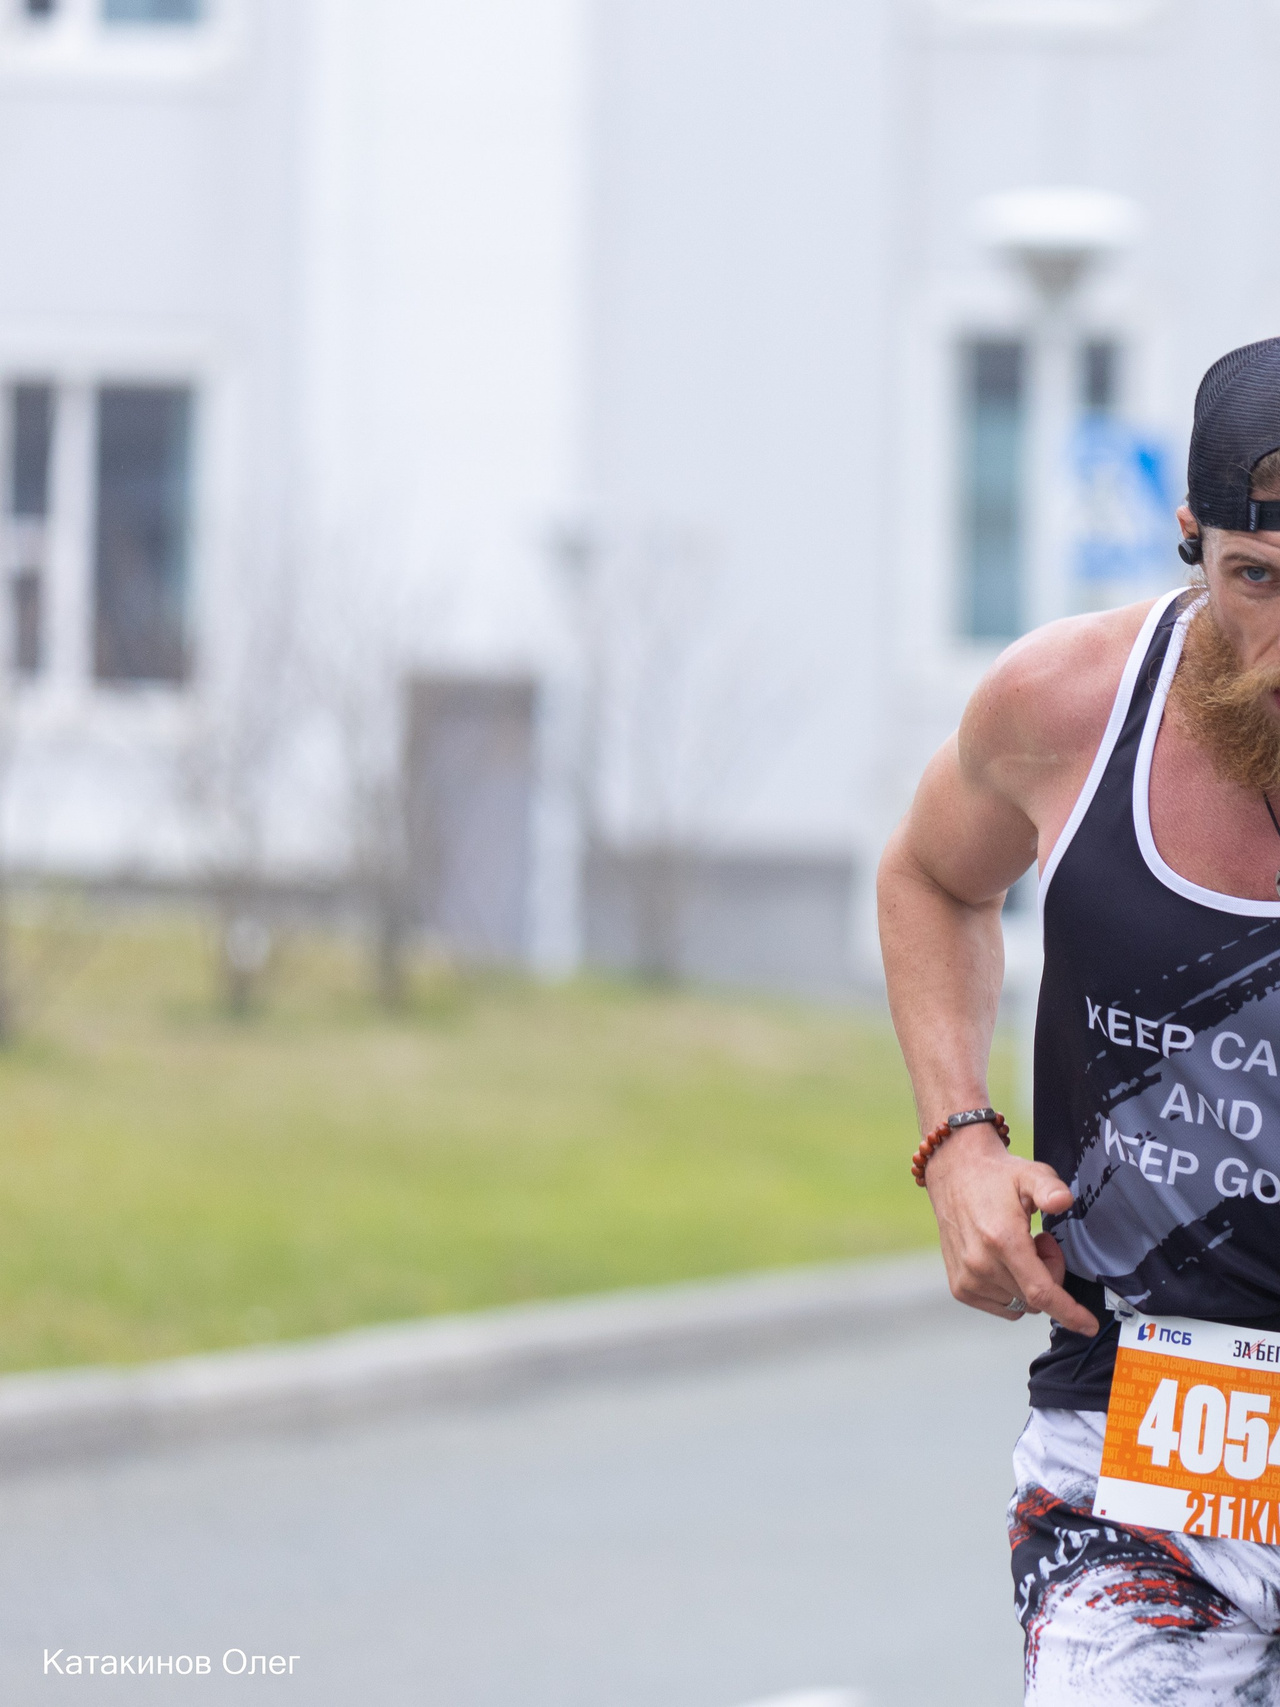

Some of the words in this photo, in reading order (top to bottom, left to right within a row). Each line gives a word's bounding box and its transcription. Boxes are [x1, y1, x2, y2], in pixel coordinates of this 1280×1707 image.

[1086, 995, 1195, 1058] KEEP
[1160, 1083, 1263, 1141] AND
[1159, 1328, 1192, 1346] ПСБ
